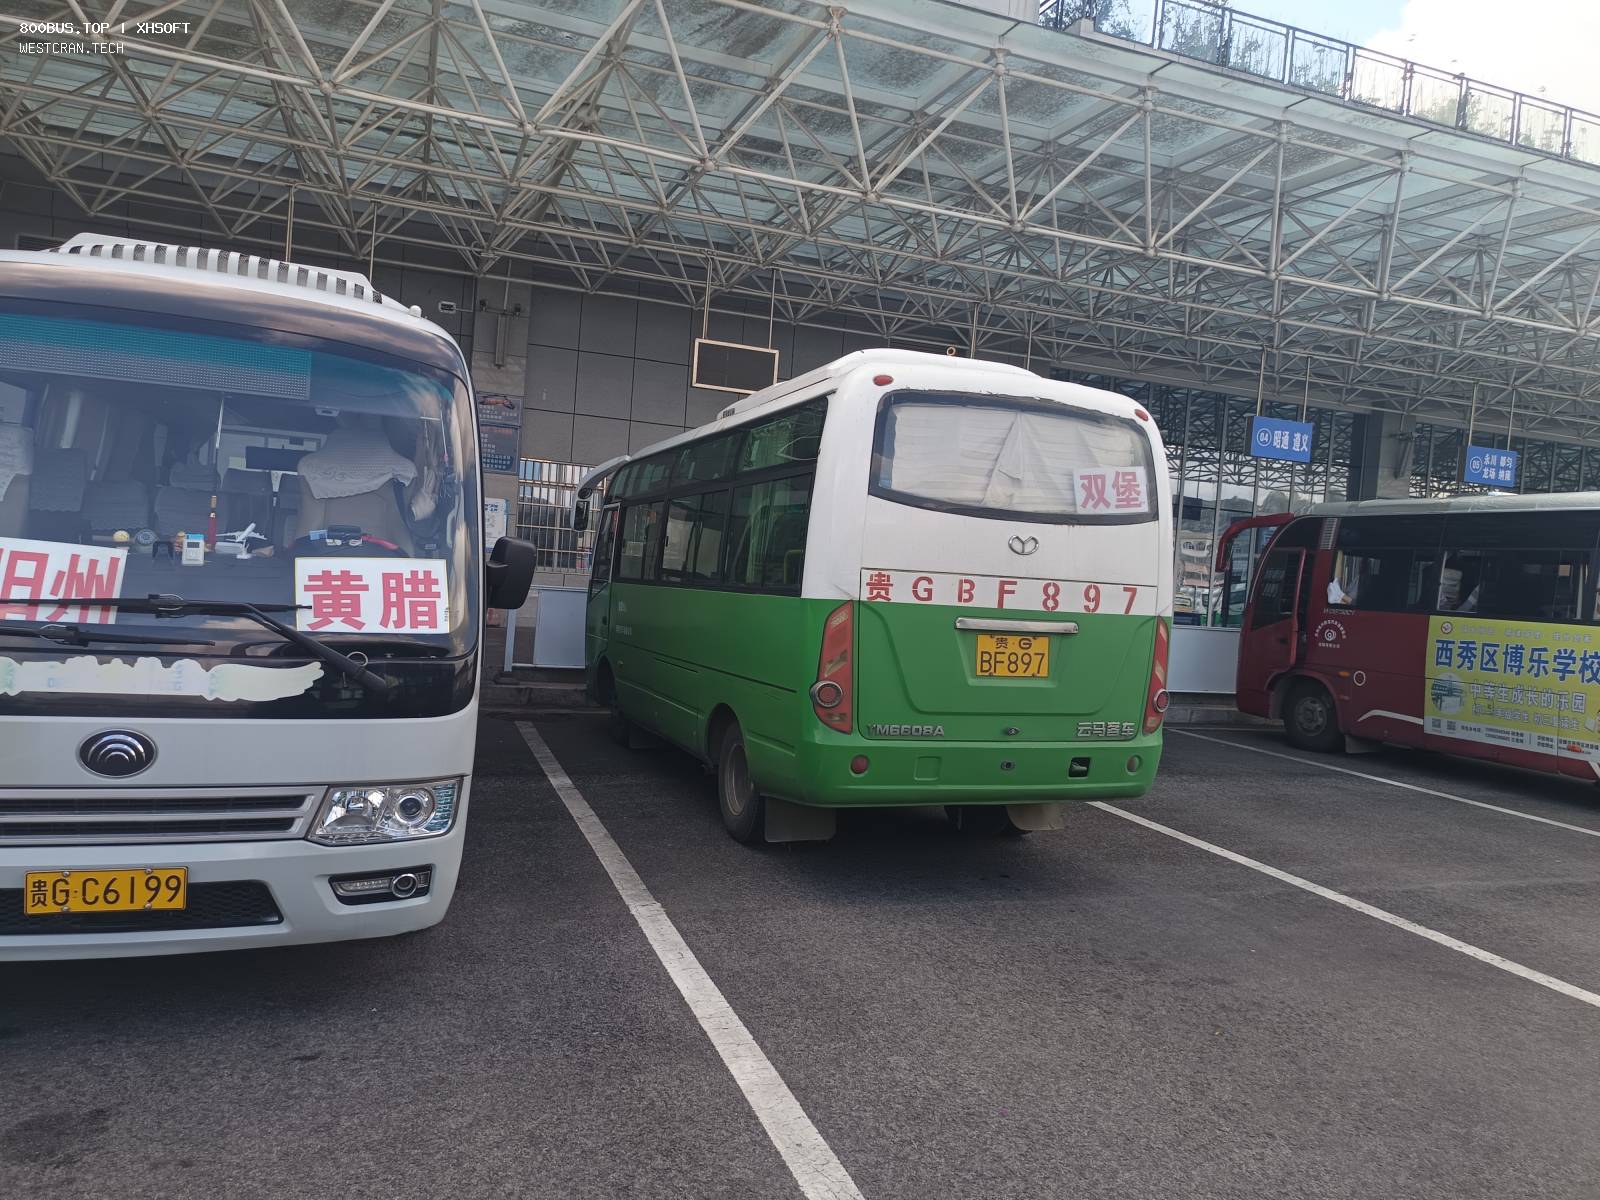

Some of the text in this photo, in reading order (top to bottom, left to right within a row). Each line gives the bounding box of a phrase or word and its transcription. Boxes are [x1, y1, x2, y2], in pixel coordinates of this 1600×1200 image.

[1079, 471, 1143, 509] 双堡
[304, 570, 441, 630] 黄腊
[980, 652, 1046, 674] BF897
[1435, 639, 1600, 684] 西秀区博乐学校
[1076, 722, 1135, 737] 云马客车
